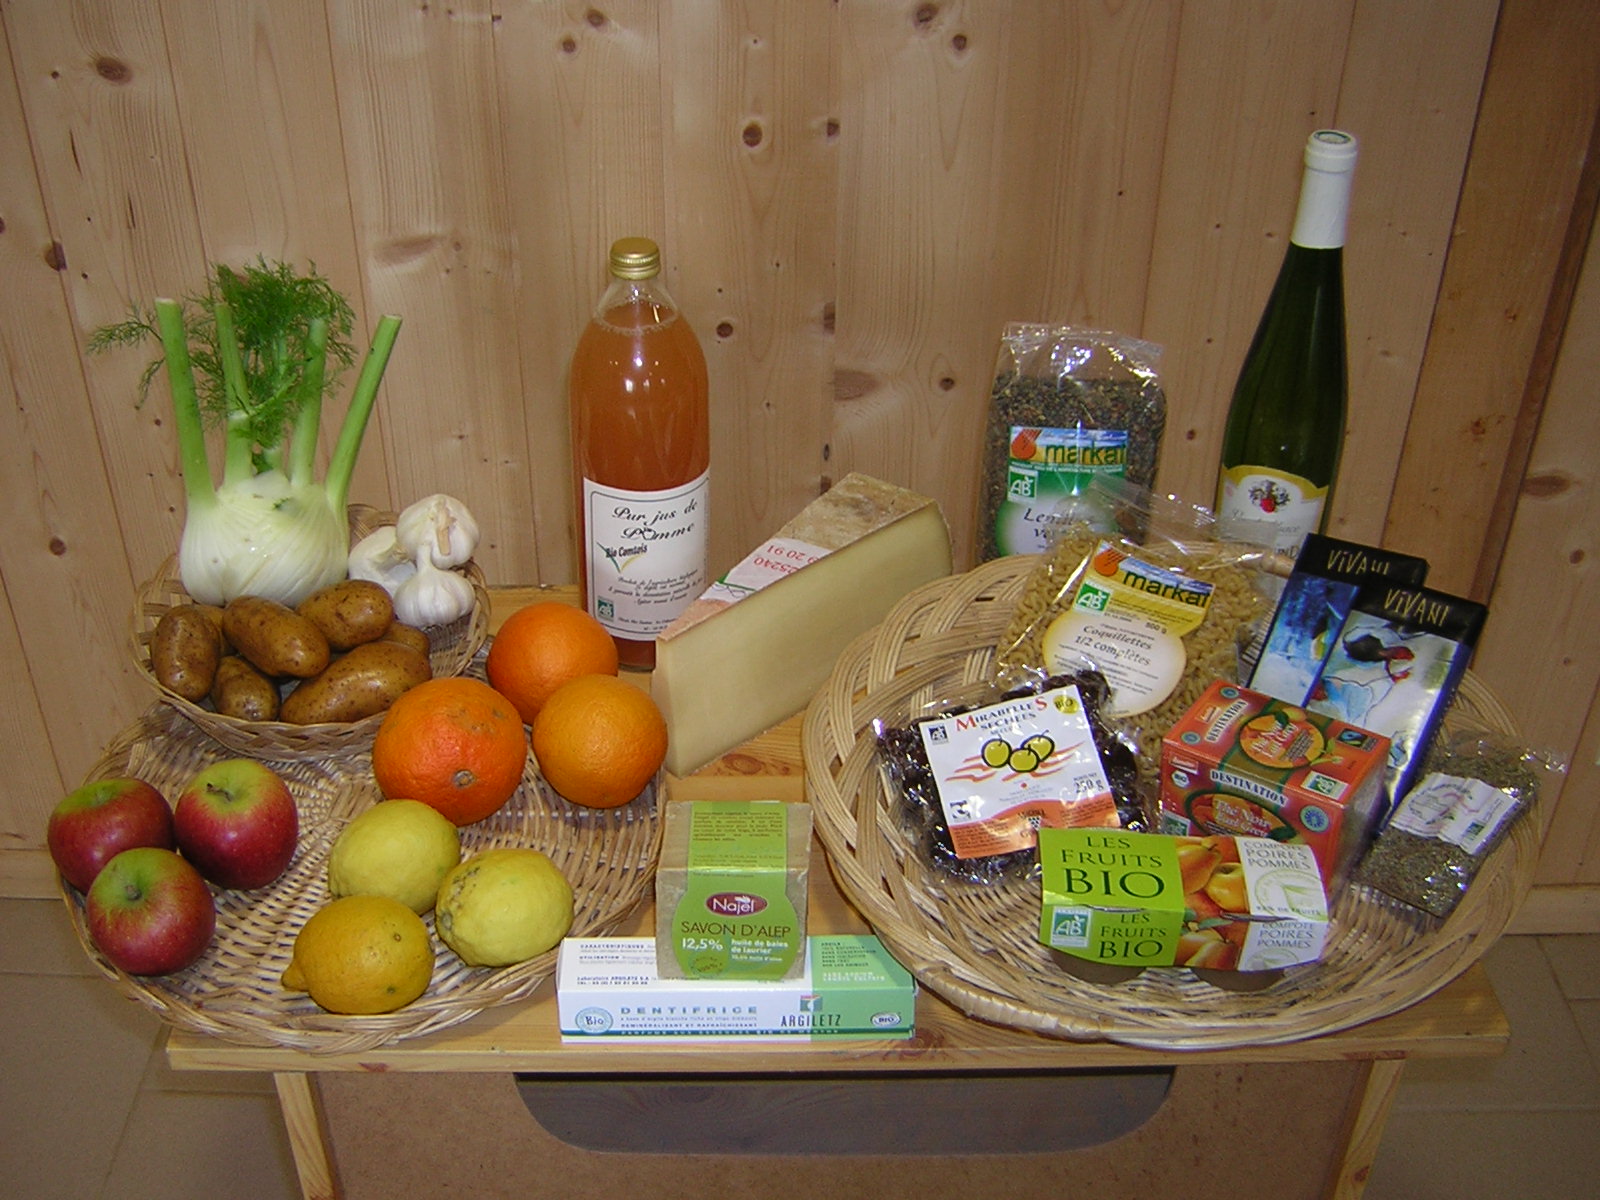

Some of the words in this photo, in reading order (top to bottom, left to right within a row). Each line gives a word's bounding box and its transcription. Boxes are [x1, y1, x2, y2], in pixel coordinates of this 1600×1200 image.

[1046, 440, 1126, 465] markal
[1010, 476, 1032, 496] AB
[612, 505, 645, 522] Pur
[643, 509, 676, 526] jus
[684, 498, 698, 514] de
[621, 523, 694, 541] Pomme
[618, 543, 648, 557] Comtois
[1122, 570, 1211, 608] markal
[1078, 592, 1104, 609] AB
[1083, 623, 1152, 650] Coquillettes
[1074, 635, 1092, 648] 1/2
[1093, 642, 1152, 667] complètes
[1055, 698, 1073, 709] BIO
[956, 696, 1048, 732] MIRABELLES
[1206, 700, 1248, 741] DESTINATION
[1211, 771, 1287, 806] DESTINATION
[1087, 836, 1130, 849] LES
[1062, 849, 1163, 868] FRUITS
[1246, 848, 1308, 860] POIRES
[1247, 858, 1311, 870] POMMES
[1064, 868, 1166, 899] BIO
[712, 898, 755, 915] Najel
[1056, 916, 1084, 936] AB
[1120, 913, 1150, 924] LES
[681, 921, 737, 937] SAVON
[741, 923, 792, 939] D'ALEP
[1101, 925, 1167, 938] FRUITS
[1259, 929, 1314, 939] POIRES
[682, 937, 724, 953] 12,5%
[743, 946, 772, 954] laurier
[1099, 939, 1163, 959] BIO
[1257, 939, 1311, 949] POMMES
[620, 1006, 758, 1015] DENTIFRICE
[585, 1015, 605, 1026] Bio
[780, 1014, 842, 1027] ARGILETZ
